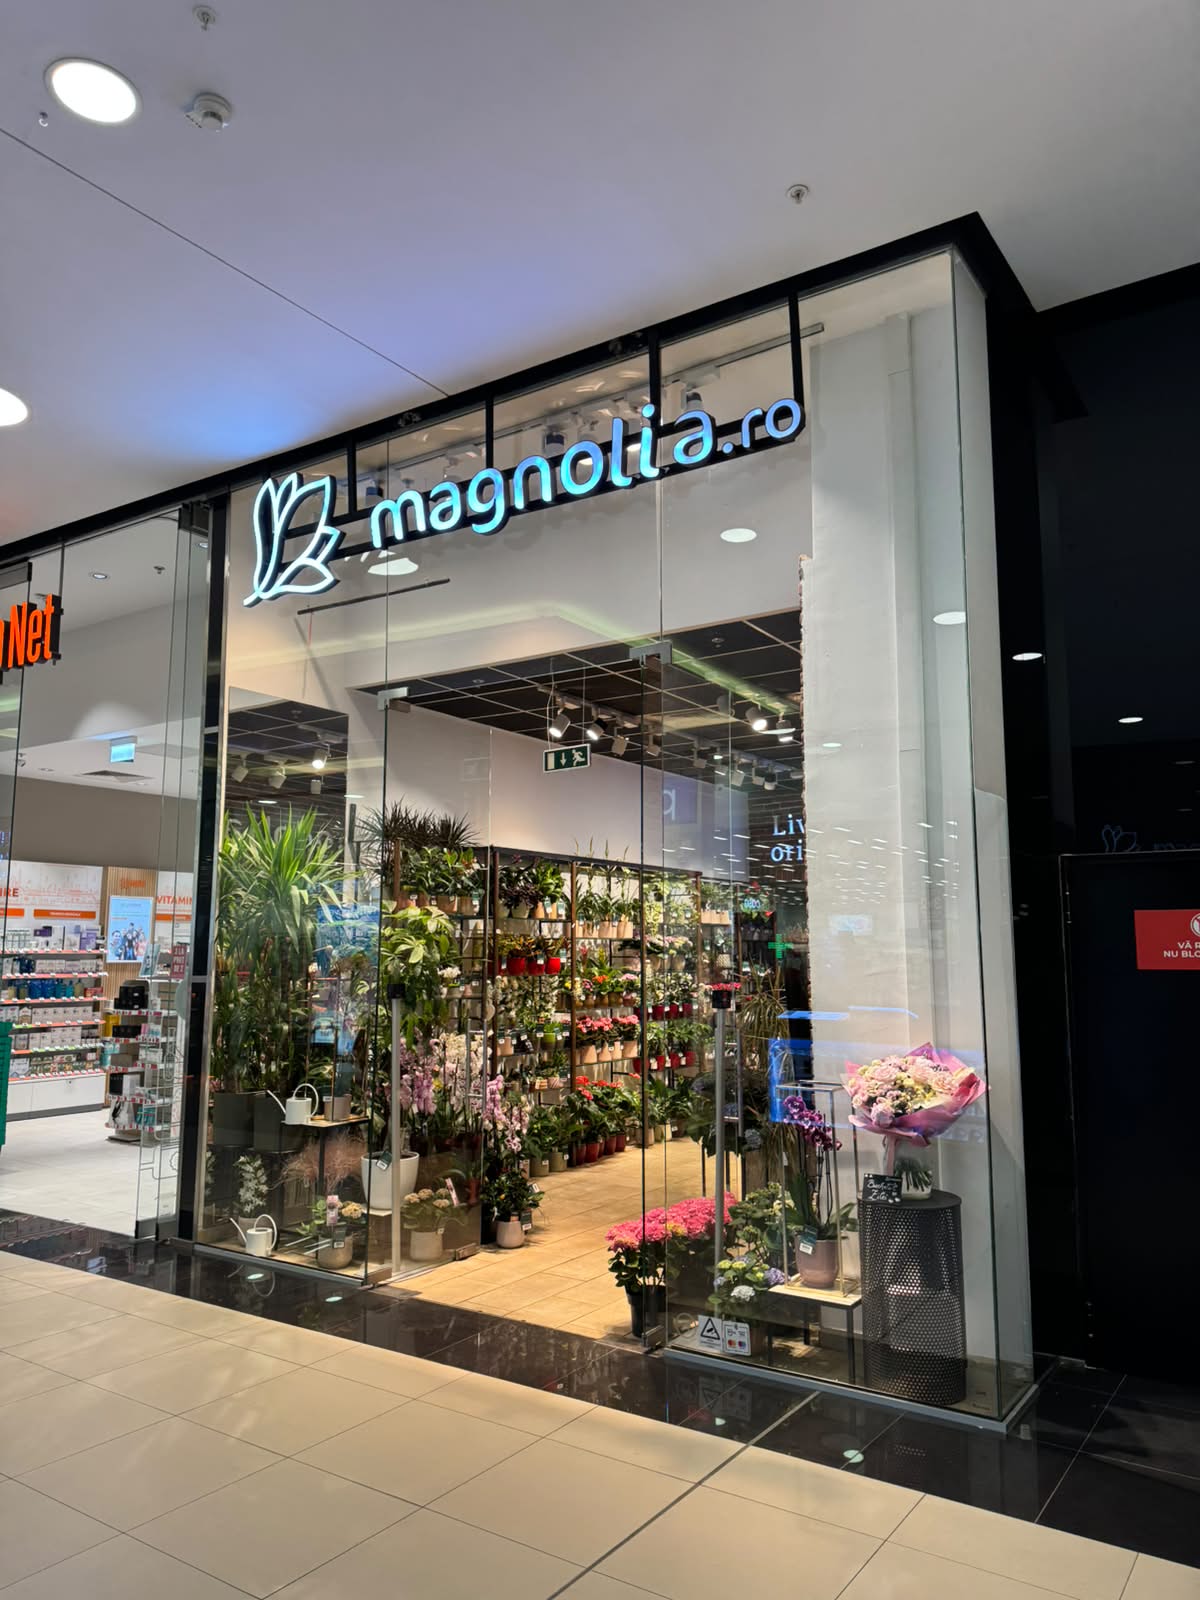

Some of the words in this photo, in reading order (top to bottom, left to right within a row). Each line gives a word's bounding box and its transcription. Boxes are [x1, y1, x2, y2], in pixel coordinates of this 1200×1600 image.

[371, 398, 803, 548] magnolia.ro
[1177, 940, 1192, 949] VĂ
[1163, 950, 1178, 958] NU
